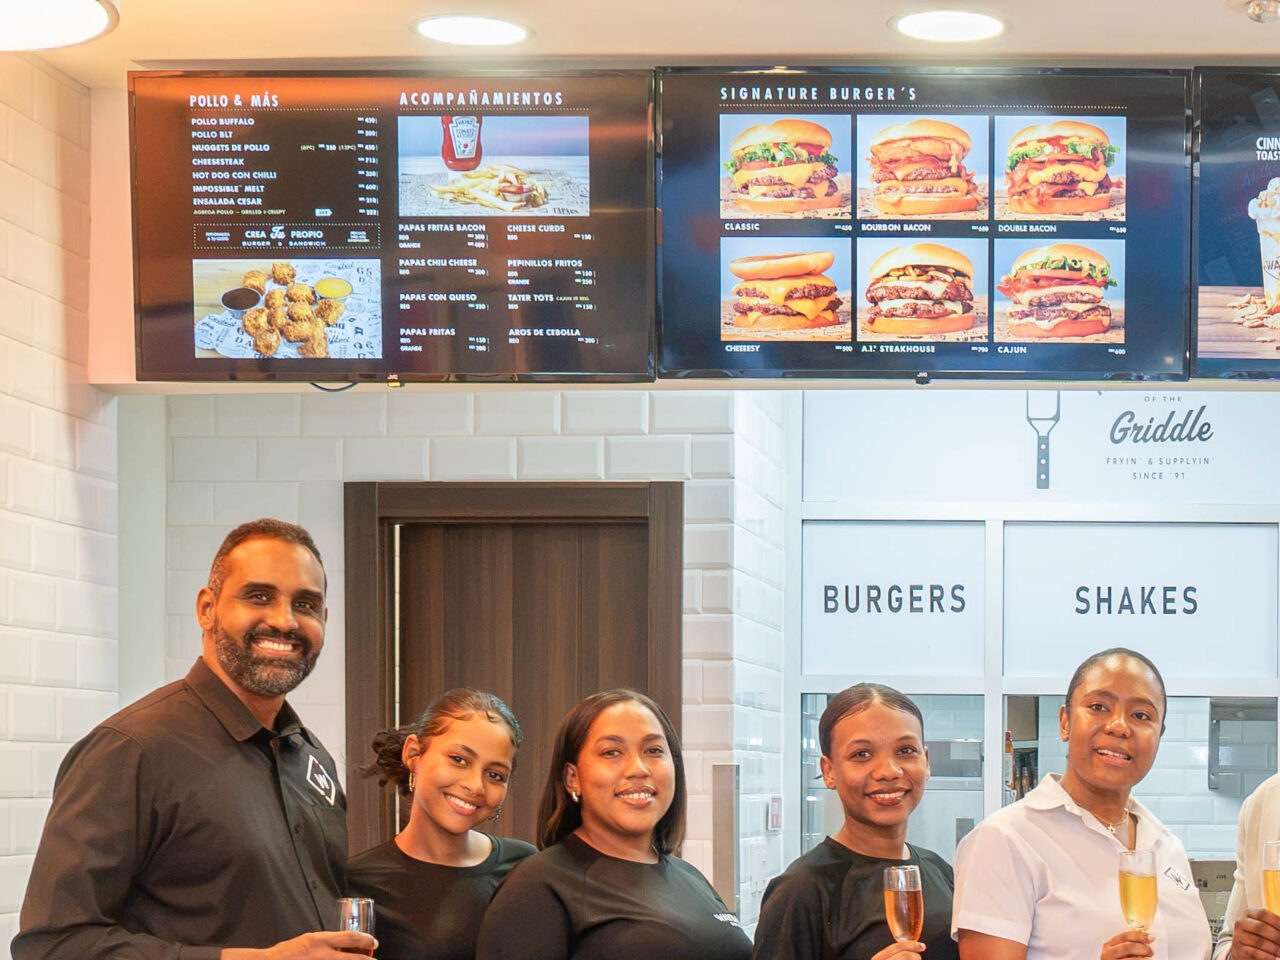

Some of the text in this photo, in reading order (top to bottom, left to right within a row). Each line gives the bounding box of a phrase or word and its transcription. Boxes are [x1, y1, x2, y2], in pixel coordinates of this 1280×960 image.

[720, 87, 818, 100] SIGNATURE
[189, 91, 279, 107] POLLO & MÁS
[400, 90, 563, 106] ACOMPAÑAMIENTOS
[191, 118, 255, 126] POLLO BUFFALO
[244, 185, 265, 193] MELT
[193, 198, 262, 206] ENSALADA CESAR
[507, 224, 565, 232] CHEESE CURDS
[724, 223, 760, 231] CLASSIC
[861, 223, 931, 231] BOURBON BACON
[998, 224, 1057, 232] DOUBLE BACON
[245, 231, 267, 239] CREA
[291, 230, 323, 239] PROPIO
[879, 345, 936, 353] STEAKHOUSE
[997, 346, 1027, 354] CAJUN
[1110, 405, 1214, 444] Griddle
[823, 584, 966, 613] BURGERS
[1075, 586, 1198, 615] SHAKES
